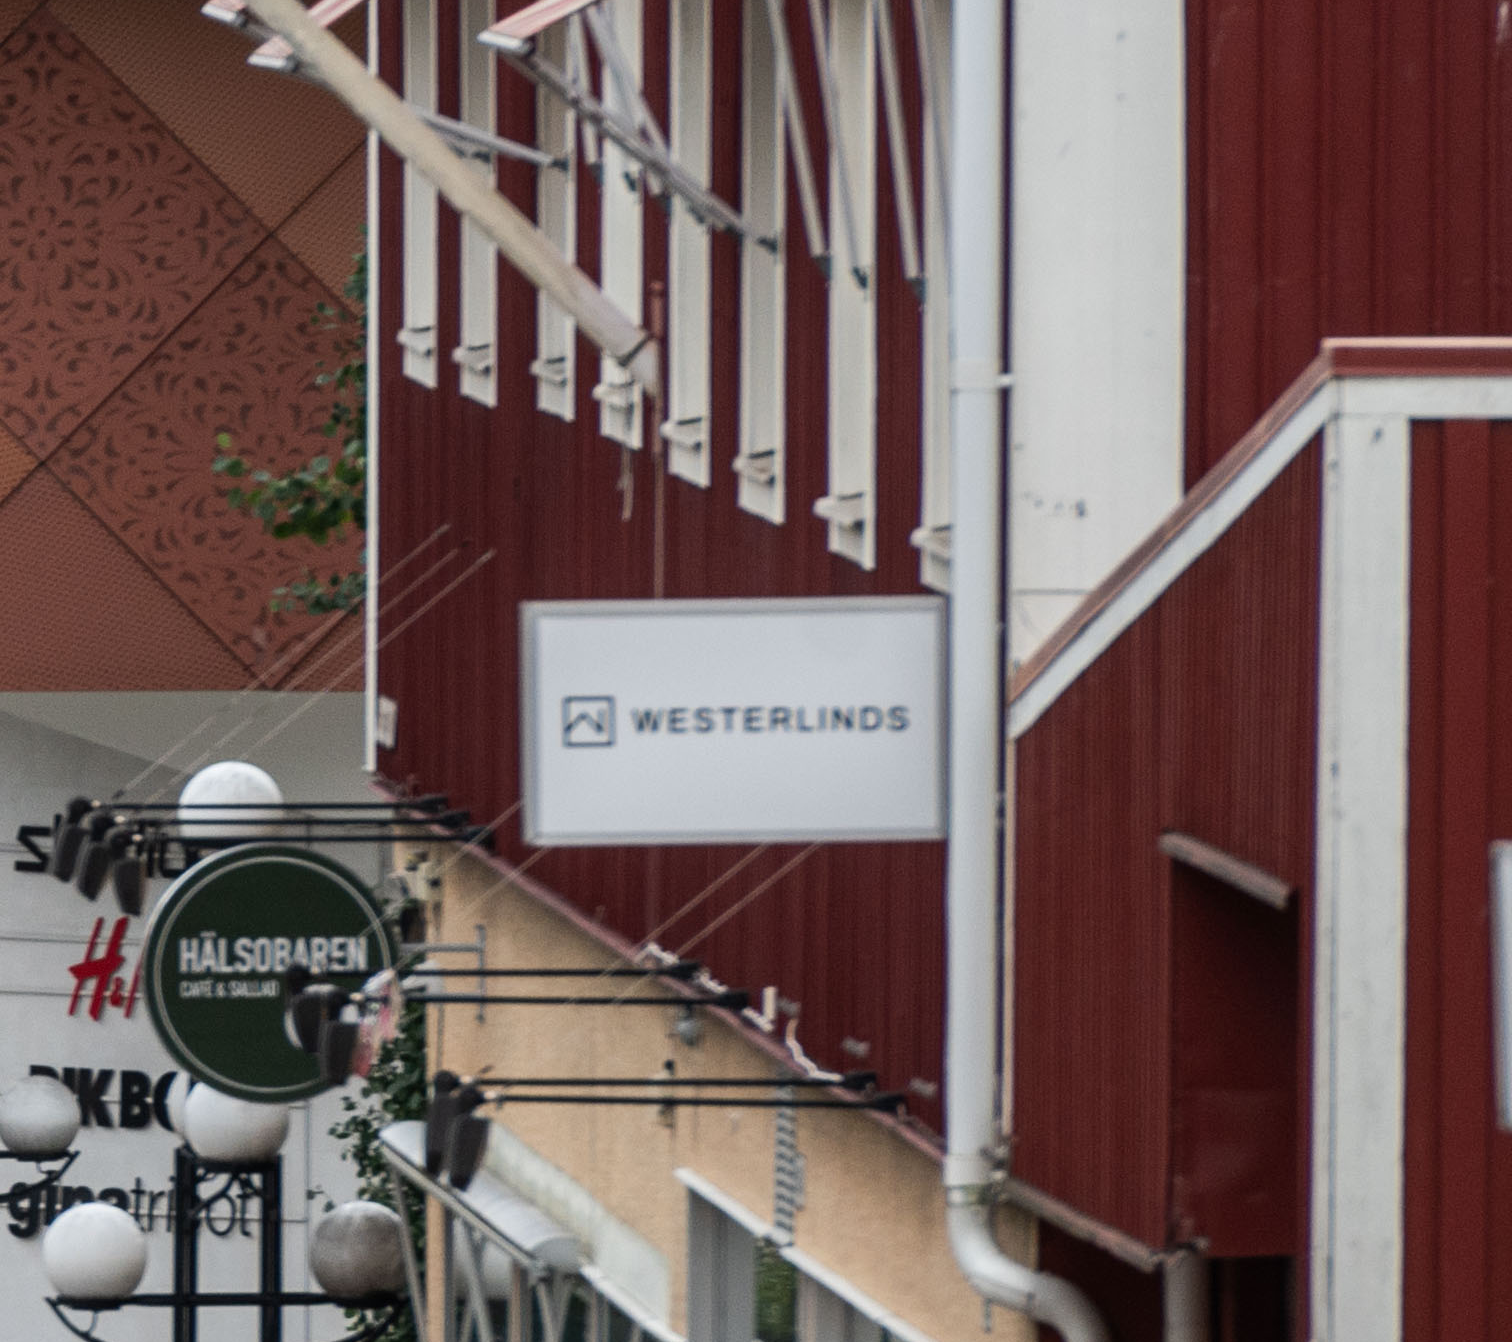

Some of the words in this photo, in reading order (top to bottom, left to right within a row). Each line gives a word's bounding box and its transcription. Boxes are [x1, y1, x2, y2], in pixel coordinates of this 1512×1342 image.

[630, 705, 911, 734] WESTERLINDS
[67, 916, 145, 1022] H&
[178, 930, 370, 976] HÄLSOBAREN
